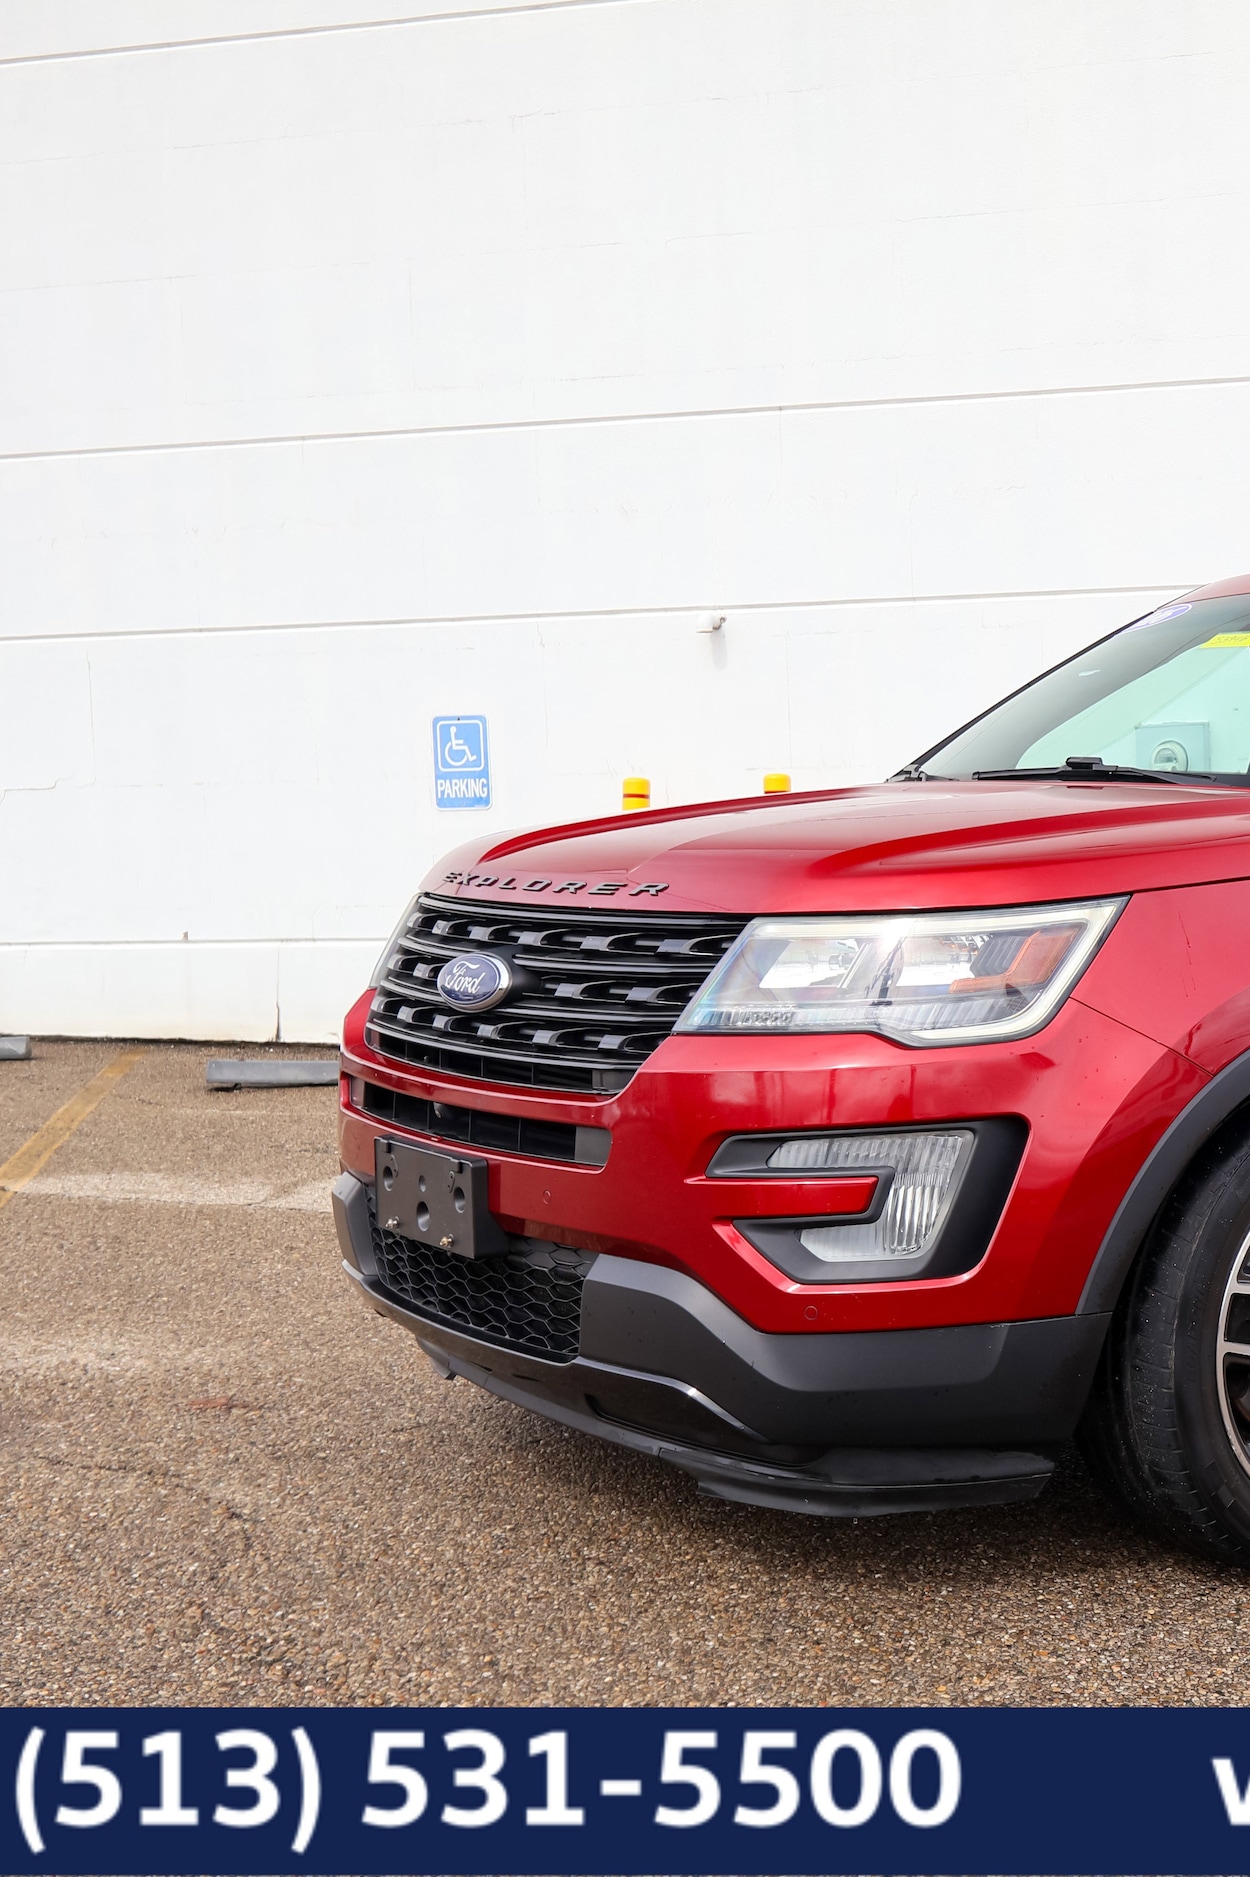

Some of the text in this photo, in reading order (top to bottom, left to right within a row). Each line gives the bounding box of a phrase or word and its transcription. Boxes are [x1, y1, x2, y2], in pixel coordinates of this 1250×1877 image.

[437, 777, 488, 799] PARKING
[442, 872, 669, 896] EXPLORER
[446, 960, 486, 994] Ford
